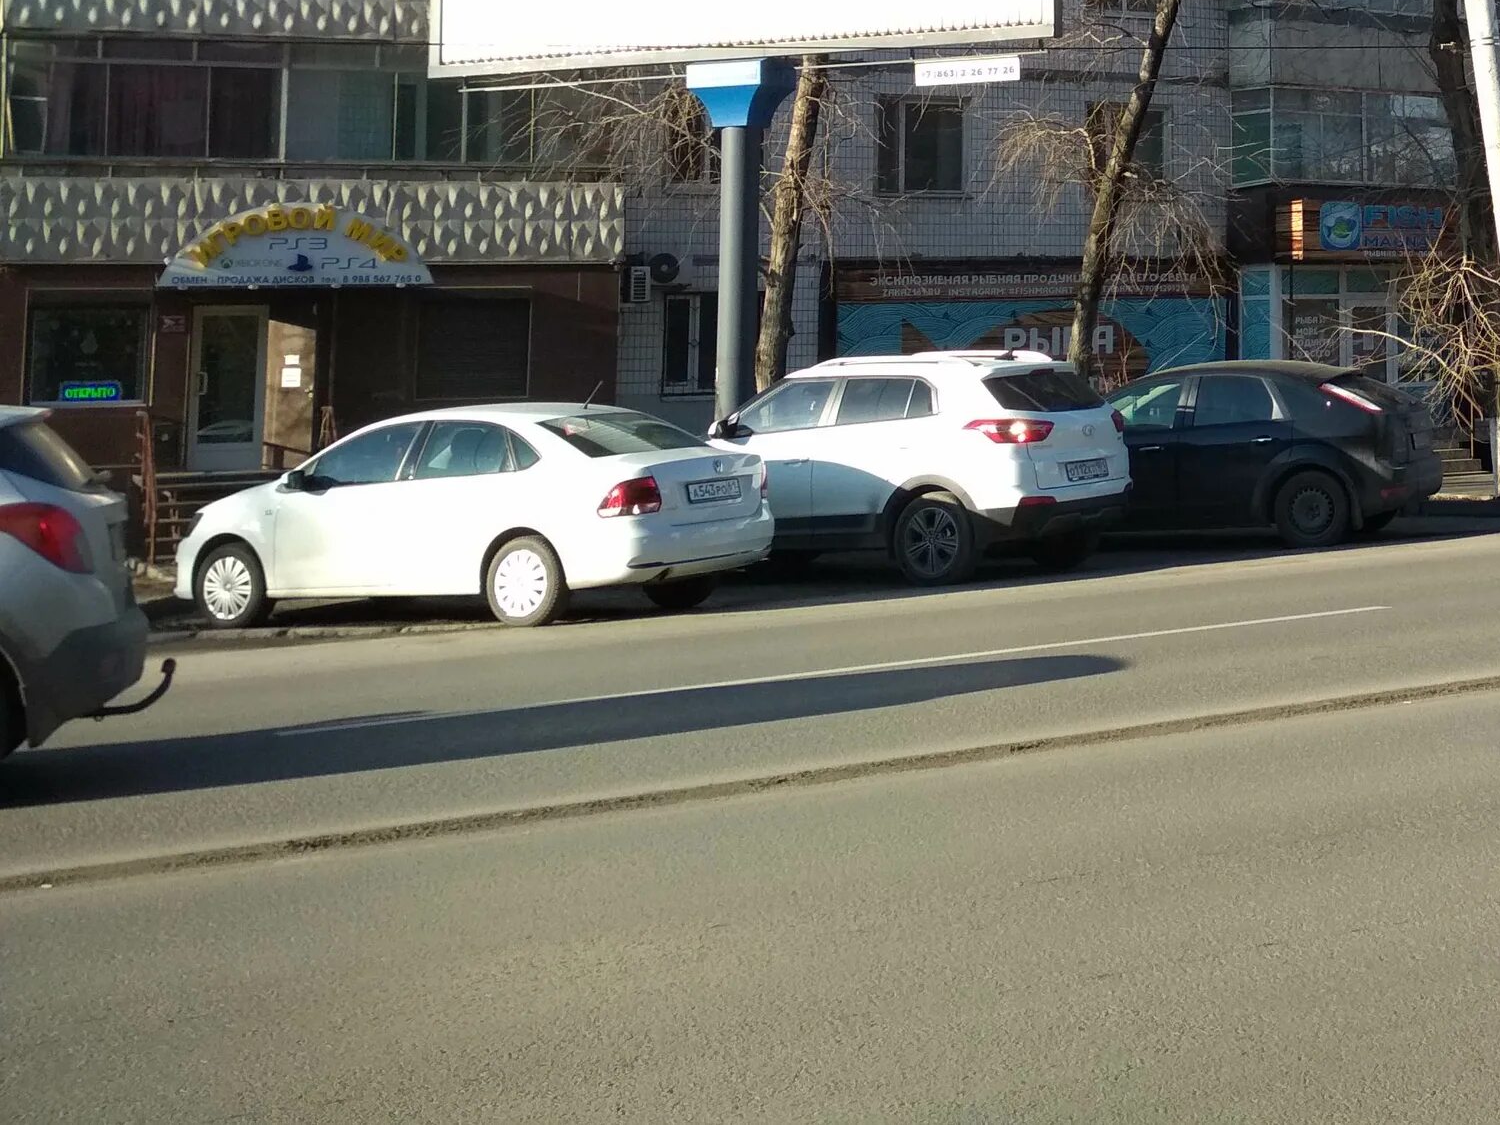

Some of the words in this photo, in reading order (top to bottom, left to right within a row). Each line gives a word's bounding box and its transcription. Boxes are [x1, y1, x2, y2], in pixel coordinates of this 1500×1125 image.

[971, 68, 983, 76] 26
[1003, 66, 1015, 74] 26
[1364, 205, 1443, 229] FISH
[190, 204, 337, 268] ИГРОВОЙ
[345, 218, 409, 263] МИР
[269, 237, 329, 251] PS3
[321, 257, 378, 270] PS4
[171, 275, 208, 284] ОБМЕН
[217, 275, 269, 285] ПРОДАЖА
[272, 275, 315, 285] ДИСКОВ
[342, 275, 349, 284] 8
[352, 275, 370, 284] 988
[373, 275, 391, 284] 567
[394, 275, 411, 284] 765
[870, 274, 969, 286] ЭКСКЛЮЗИВНАЯ
[971, 274, 1020, 285] РЫБНАЯ
[1004, 325, 1114, 357] РЫА
[64, 387, 116, 399] ОТКРЫТО
